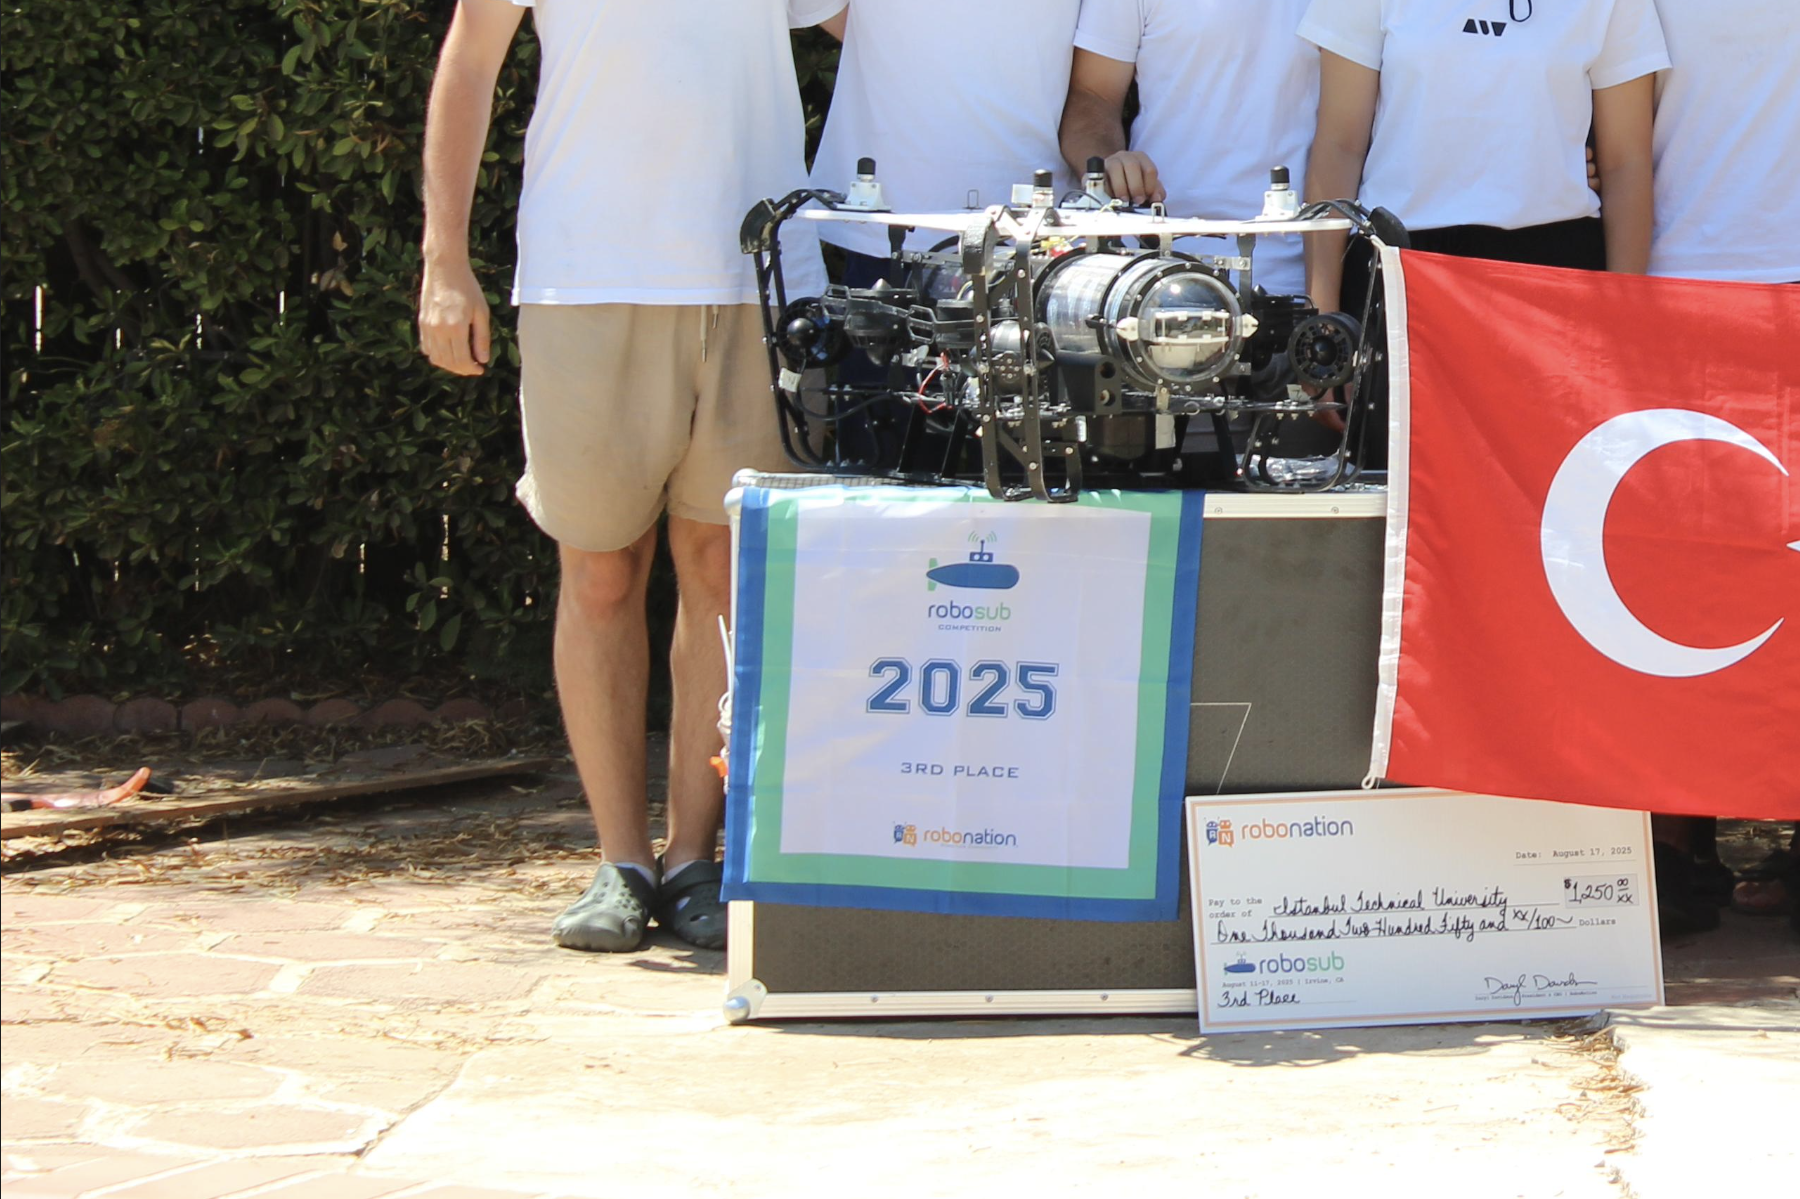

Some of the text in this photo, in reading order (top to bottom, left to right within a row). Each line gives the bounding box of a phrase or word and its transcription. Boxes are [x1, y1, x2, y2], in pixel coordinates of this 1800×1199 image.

[927, 598, 1012, 621] robosub
[938, 623, 1002, 633] COMPETITION
[865, 656, 1060, 722] 2025
[900, 762, 1020, 780] 3RD PLACE
[923, 826, 1018, 847] robonation
[1241, 815, 1354, 840] robonation
[1515, 846, 1633, 860] Date: August 17, 2025
[1208, 898, 1225, 908] Pay
[1246, 897, 1262, 905] the
[1273, 884, 1509, 916] Istanbul Technical University
[1208, 910, 1252, 919] order of
[1579, 918, 1616, 926] Dollars
[1217, 919, 1250, 943] One
[1252, 918, 1340, 942] Thousand
[1339, 916, 1370, 937] Two
[1371, 914, 1434, 937] Hundred
[1435, 911, 1475, 943] Fifty
[1479, 910, 1509, 932] and
[1259, 950, 1346, 975] robosub
[1221, 981, 1247, 989] August
[1218, 988, 1301, 1008] 3rd Place
